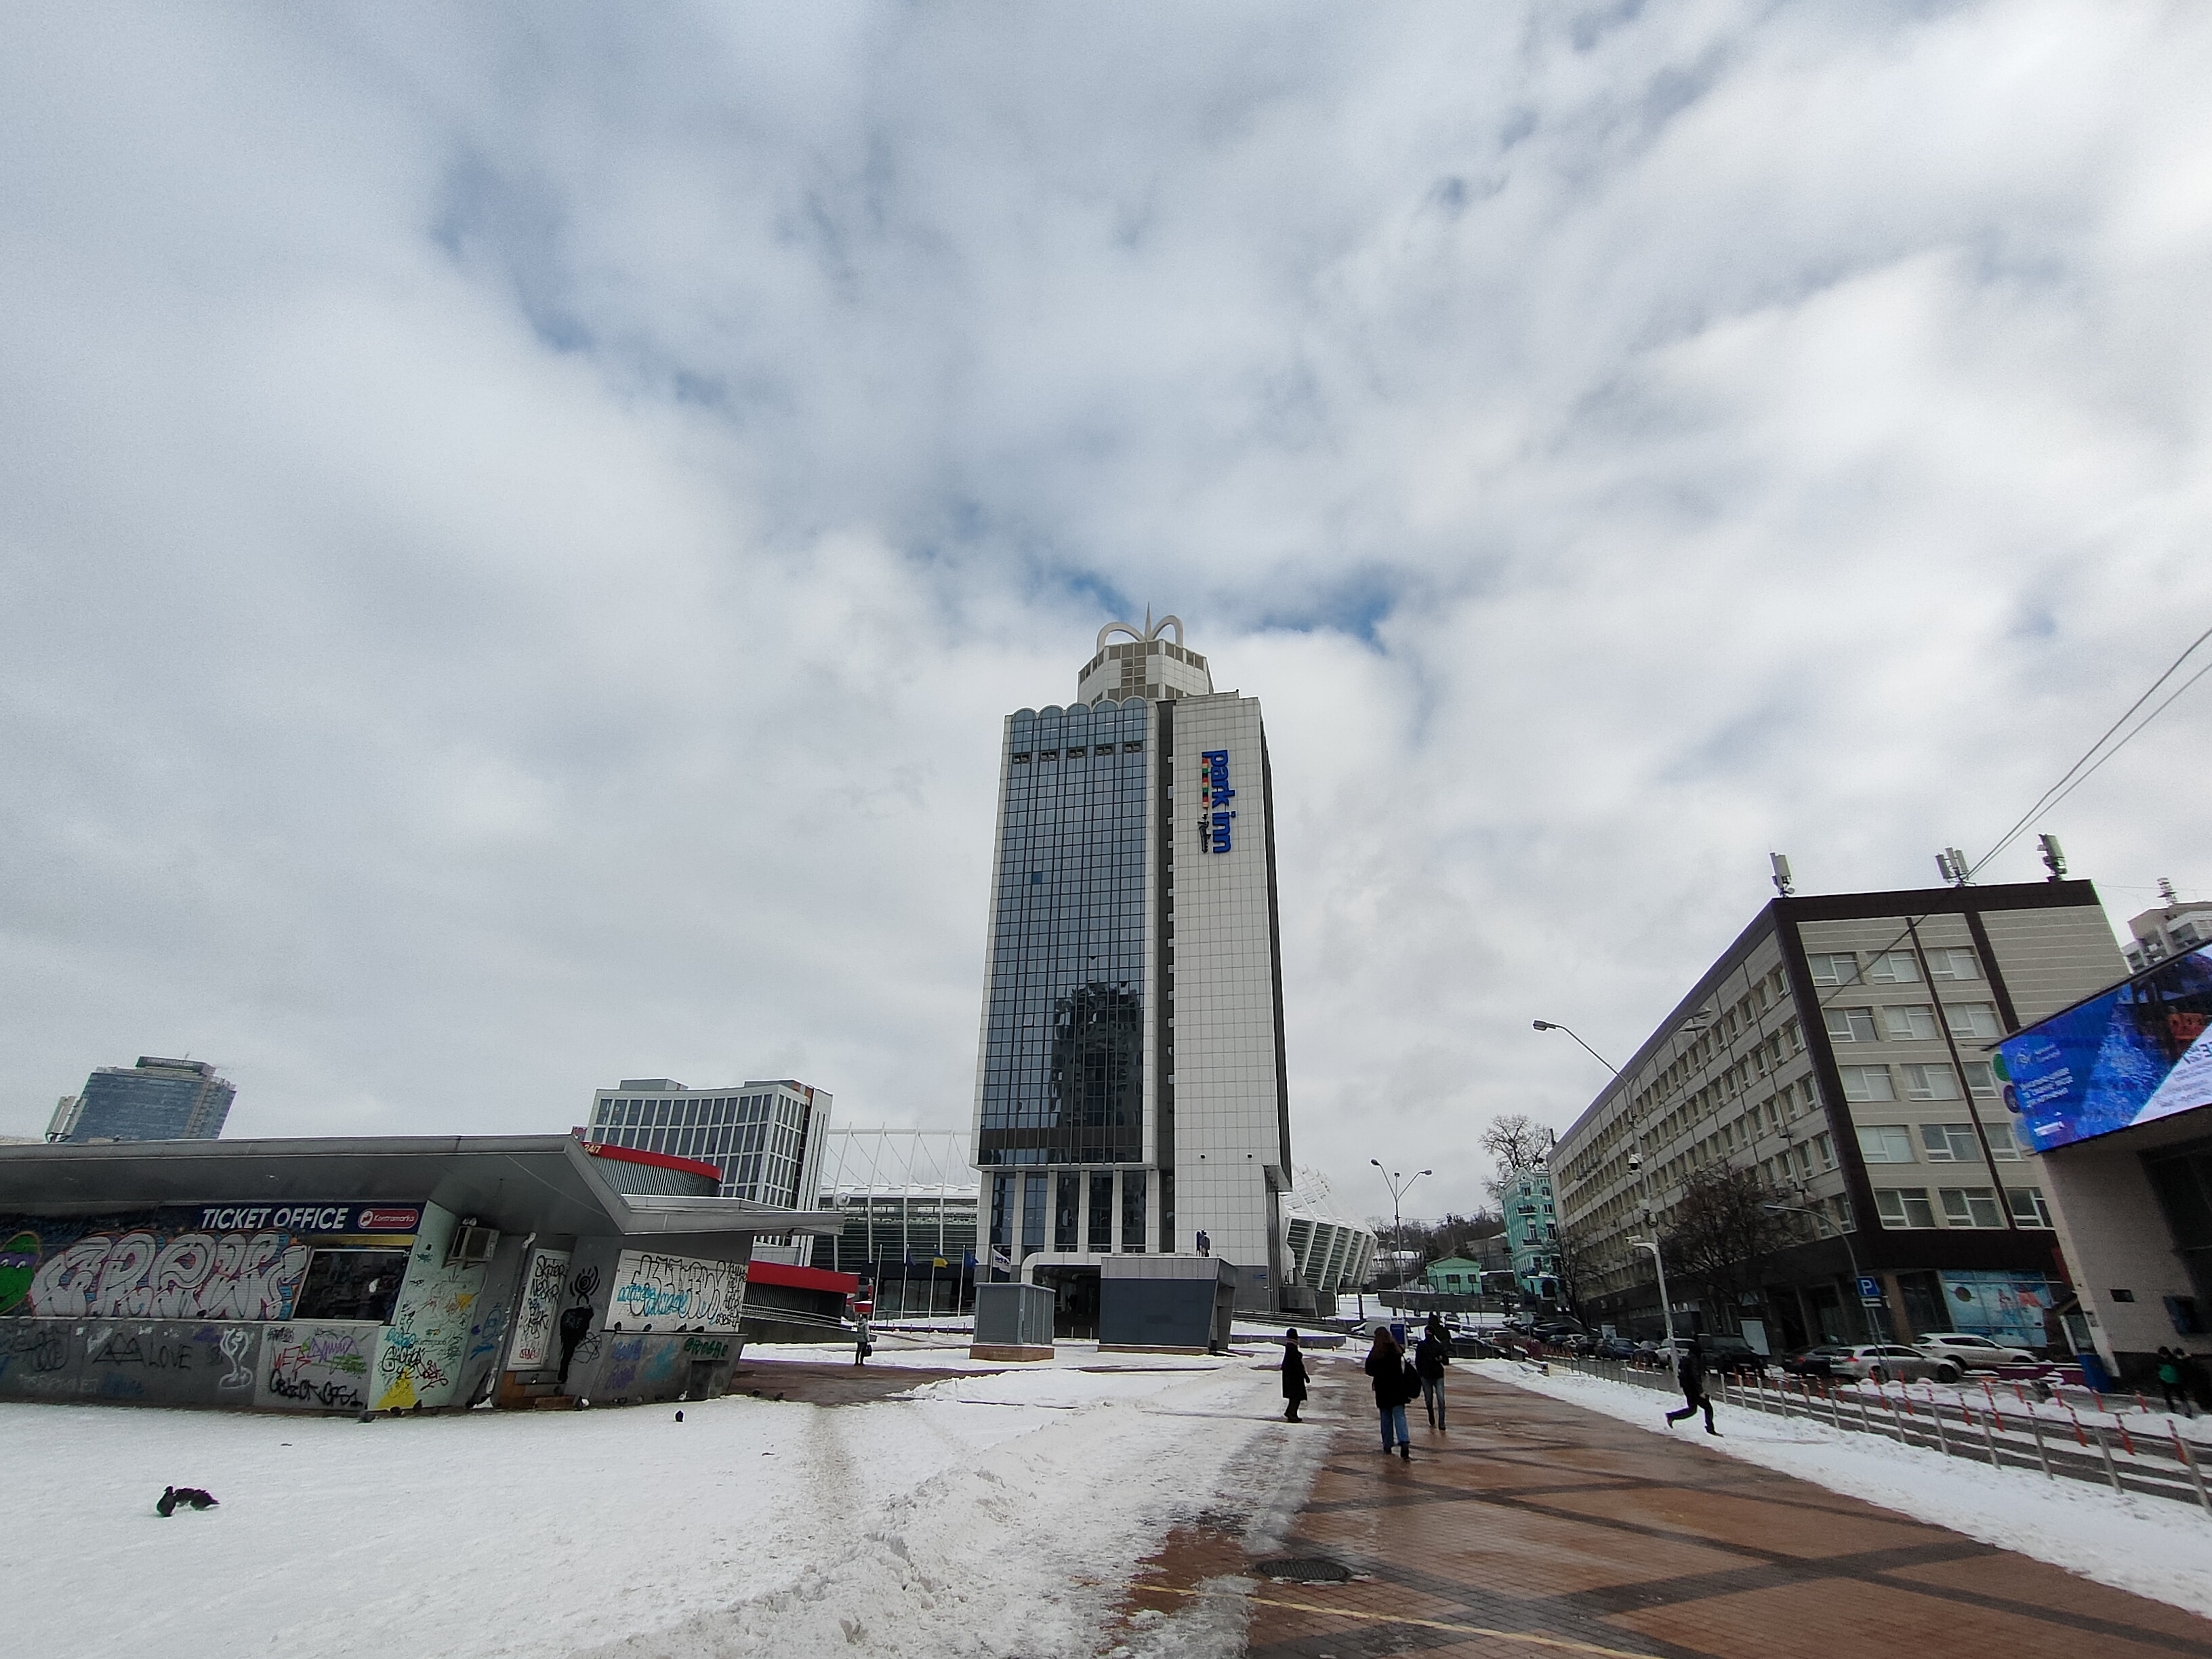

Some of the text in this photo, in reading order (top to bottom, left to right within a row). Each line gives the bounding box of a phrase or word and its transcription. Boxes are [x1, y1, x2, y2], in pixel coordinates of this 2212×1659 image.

[1202, 750, 1235, 808] park
[1212, 811, 1236, 853] inn
[201, 1208, 349, 1229] TICKET OFFICE
[1860, 1279, 1872, 1295] P
[148, 1342, 192, 1369] LOVE
